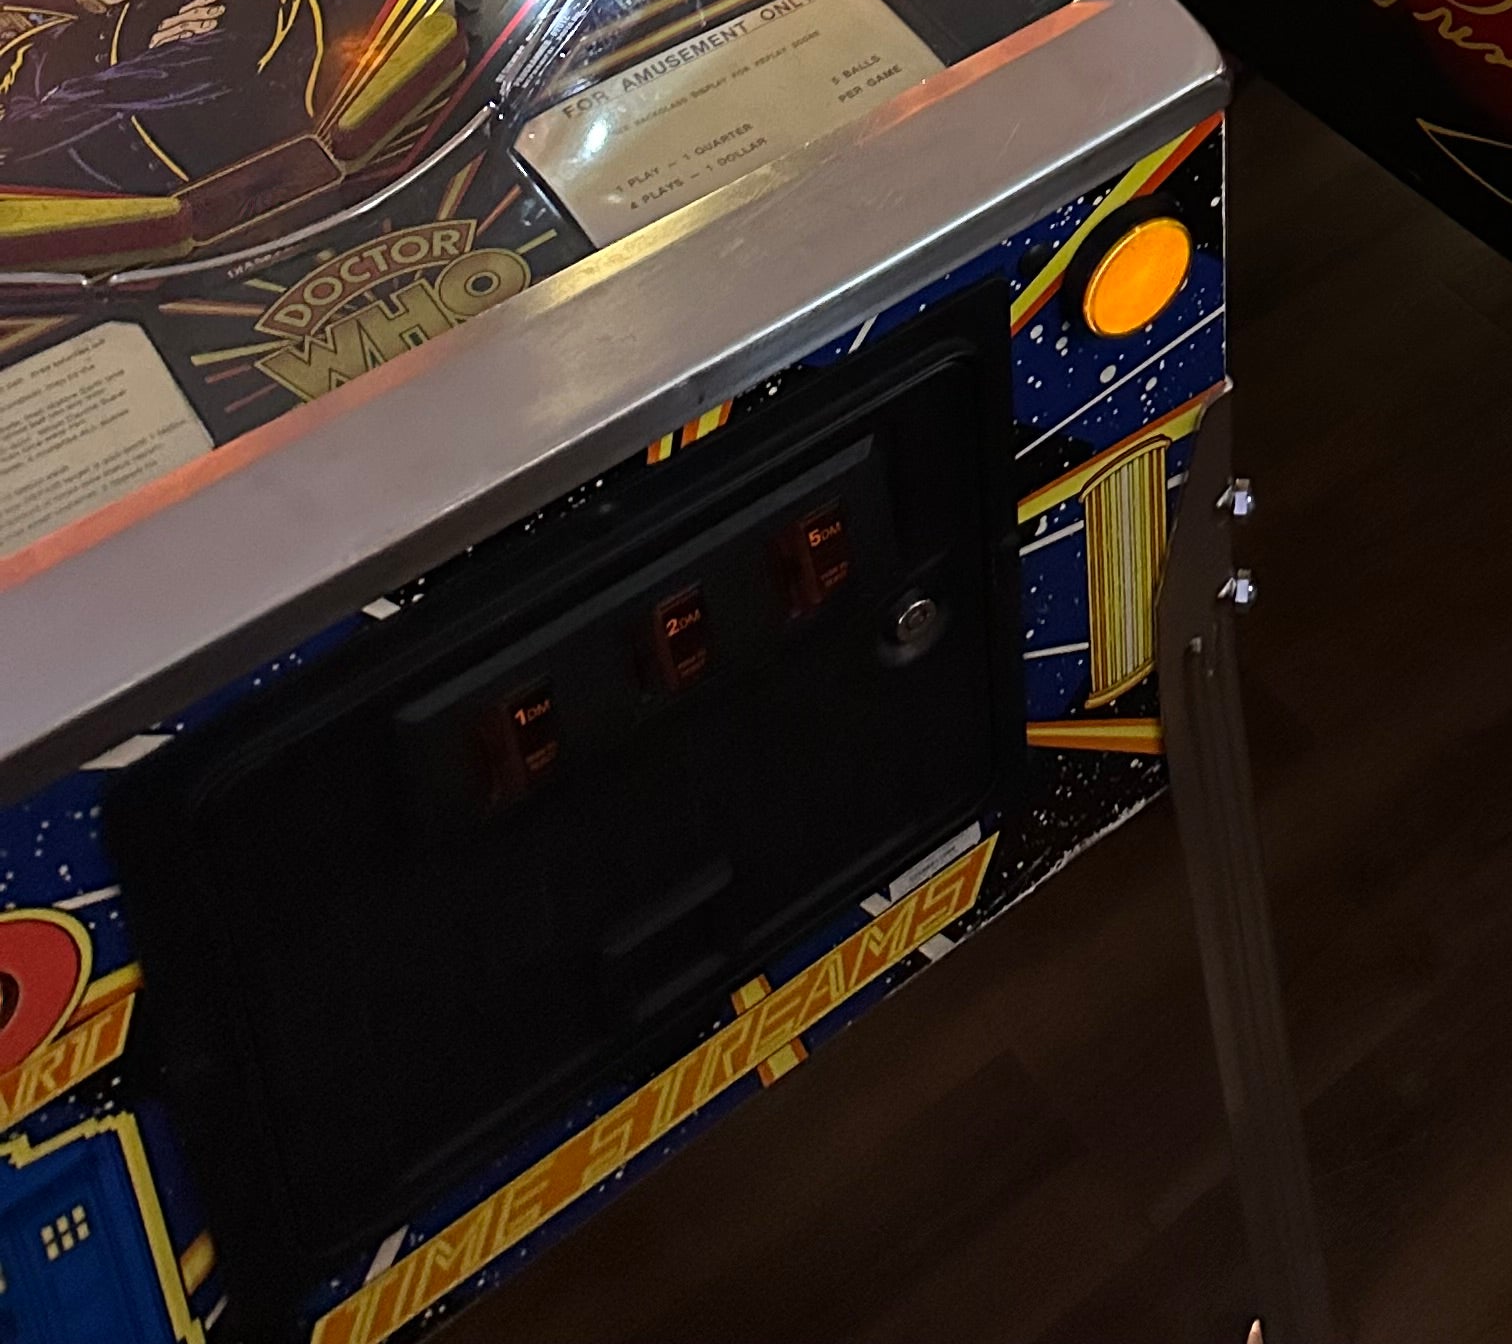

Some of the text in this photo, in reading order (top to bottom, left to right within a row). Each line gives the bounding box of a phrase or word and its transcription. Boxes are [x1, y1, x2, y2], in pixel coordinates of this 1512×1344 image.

[562, 88, 610, 121] FOR
[622, 20, 751, 94] AMUSEMENT
[836, 63, 904, 103] PER GAME
[842, 53, 882, 82] BALLS
[626, 165, 661, 192] PLAY
[693, 122, 754, 157] QUARTER
[640, 178, 685, 208] PLAYS
[716, 135, 769, 169] DOLLAR
[254, 248, 532, 404] WHO
[273, 228, 462, 329] DOCTOR
[580, 862, 974, 1191] STREAMS
[346, 1162, 556, 1344] TIME
